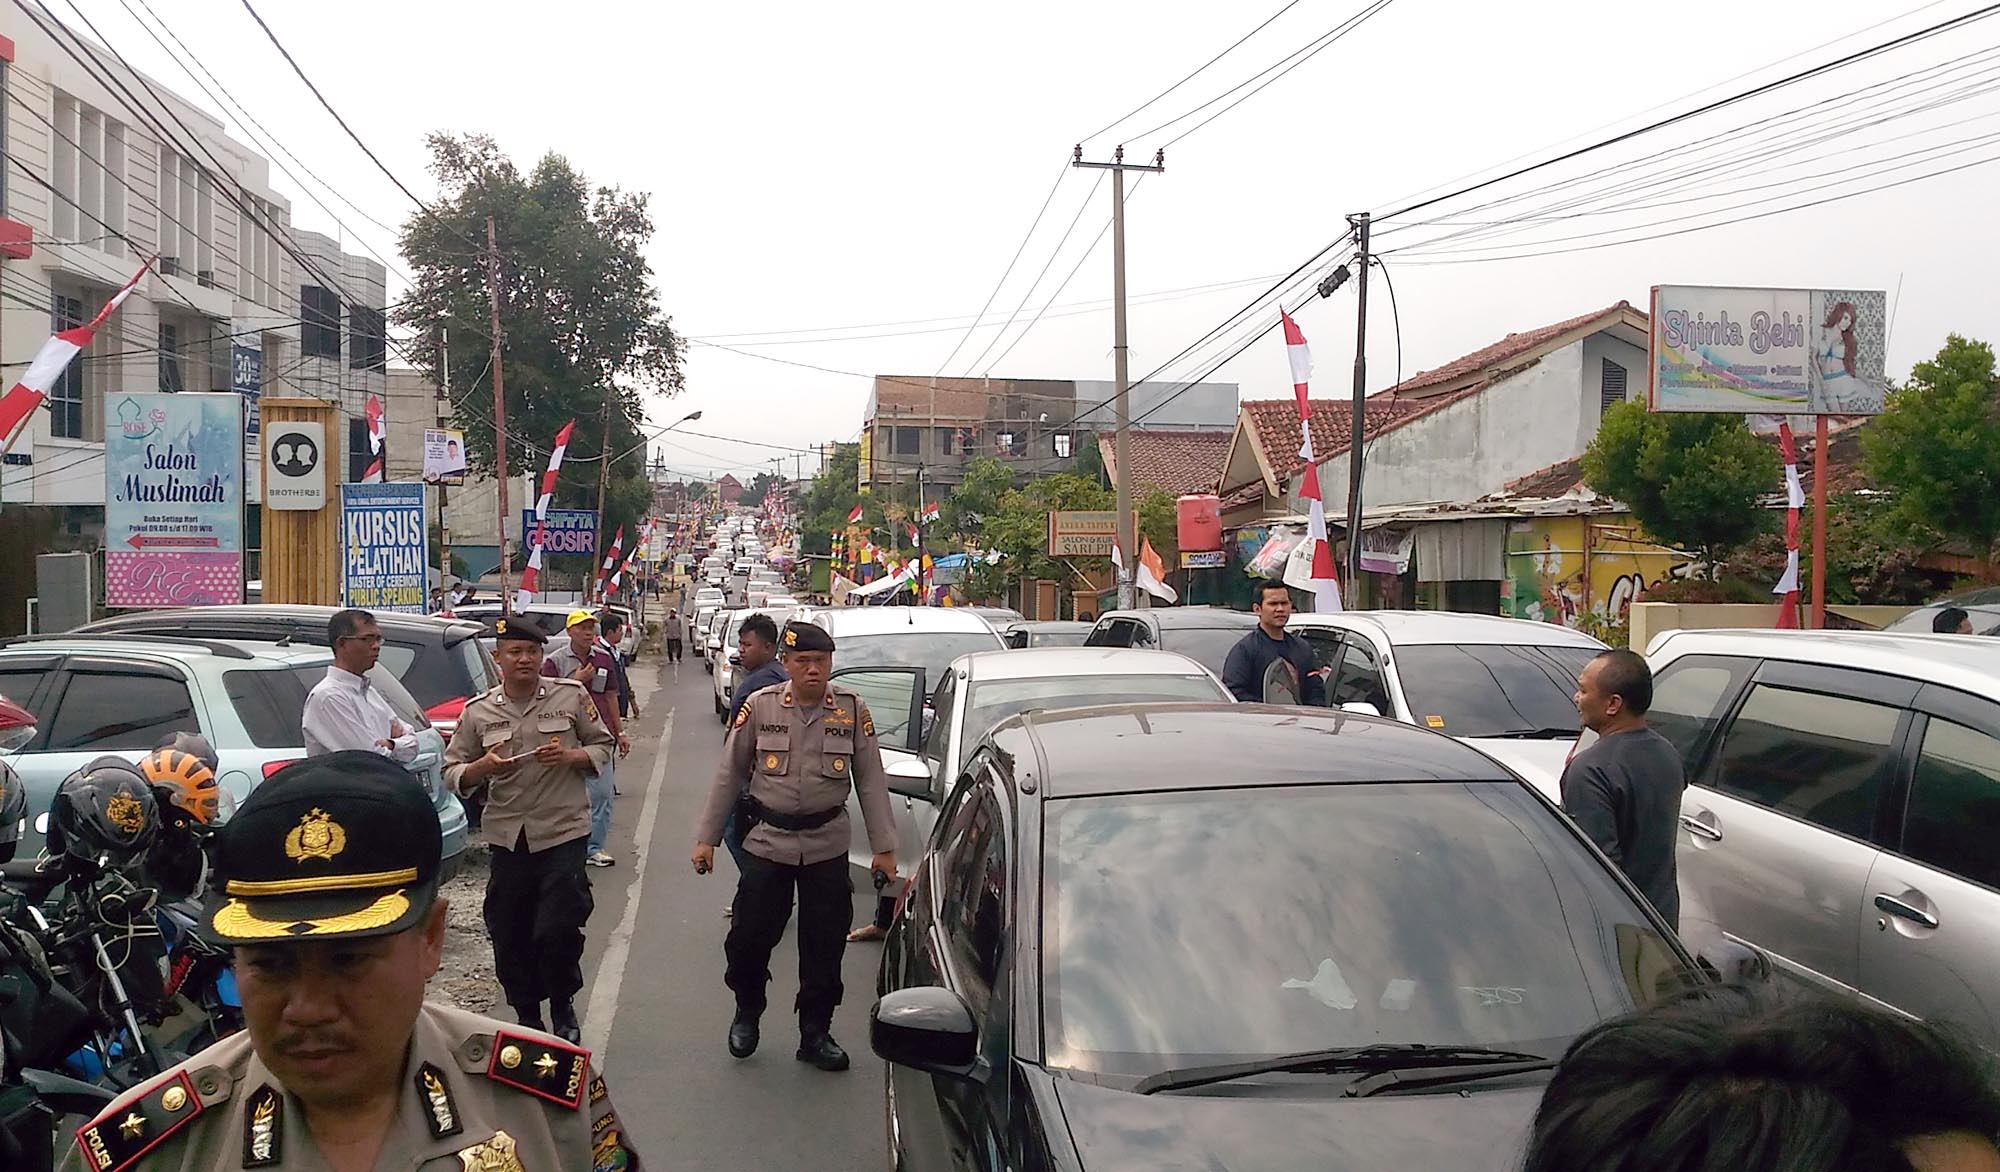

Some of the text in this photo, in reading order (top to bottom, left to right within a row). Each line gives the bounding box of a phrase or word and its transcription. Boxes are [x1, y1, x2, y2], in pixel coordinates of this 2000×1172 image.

[1664, 310, 1804, 354] Shinta Bebi
[144, 443, 197, 470] Salon
[116, 474, 225, 503] Muslimah
[347, 510, 421, 546] KURSUS
[526, 529, 594, 553] GROSIR
[1061, 536, 1089, 544] SALON
[349, 546, 422, 576] PELATIHAN
[1063, 543, 1092, 554] SARI
[349, 574, 422, 589] MASTER OF CEREMONY
[349, 587, 423, 607] PUBLIC SPEAKING
[565, 1055, 585, 1098] POLISI
[85, 1127, 113, 1170] POLISI
